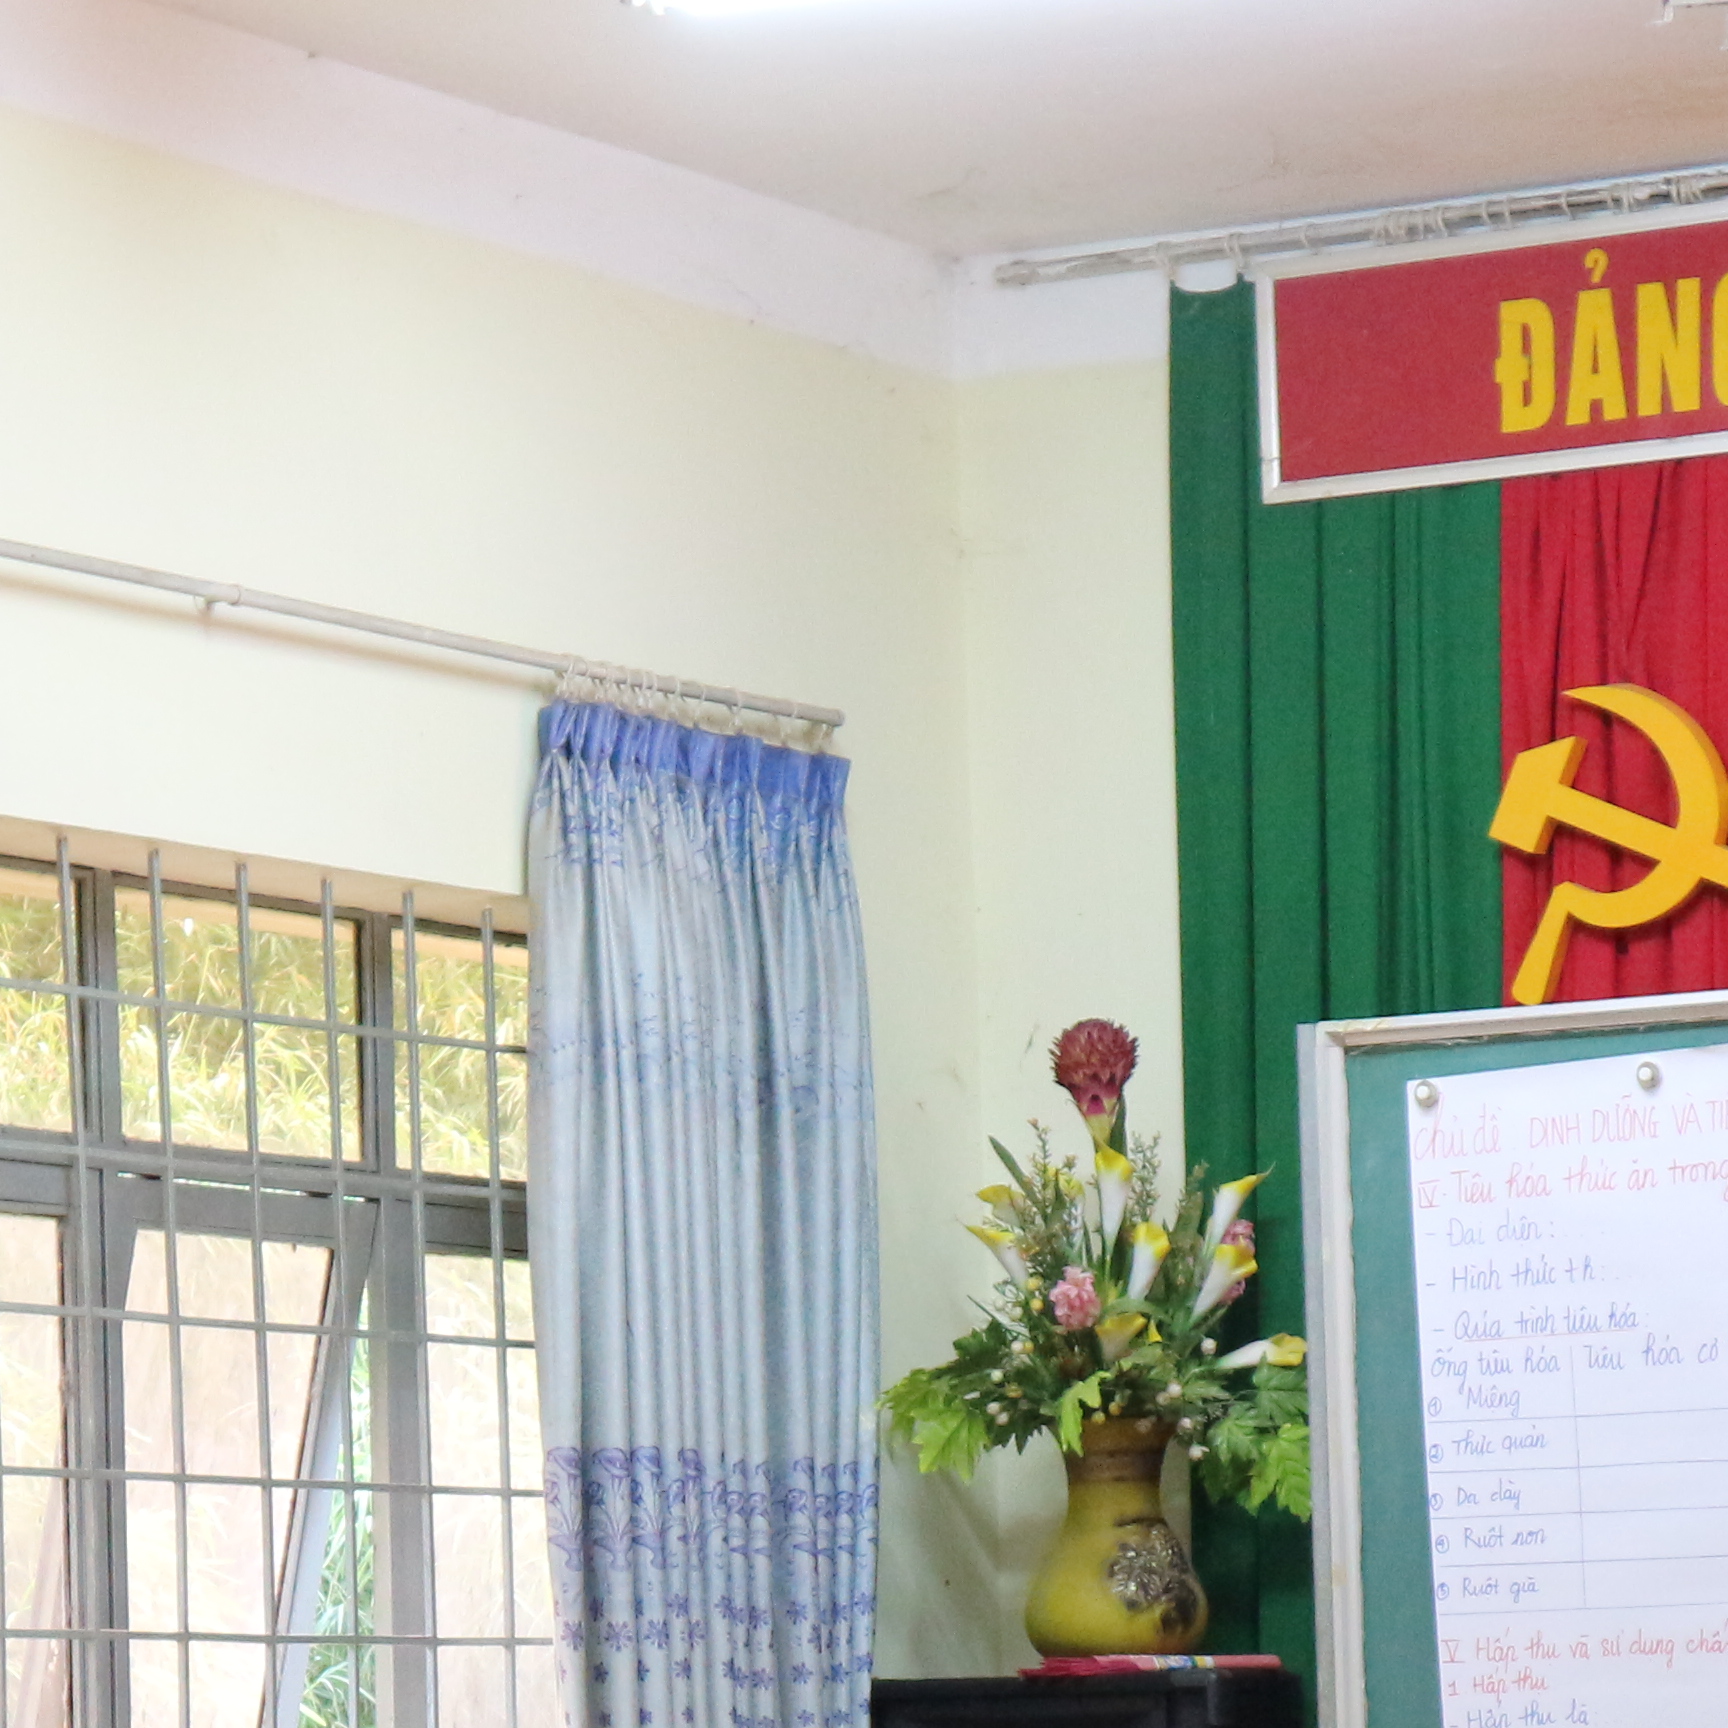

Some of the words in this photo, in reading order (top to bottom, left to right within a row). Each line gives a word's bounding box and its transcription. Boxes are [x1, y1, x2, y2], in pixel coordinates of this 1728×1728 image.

[1529, 1113, 1581, 1149] DINH
[1671, 1092, 1704, 1135] VÀ
[1450, 1170, 1497, 1205] Tiêu
[1627, 1159, 1659, 1191] ăn
[1452, 1258, 1502, 1292] Hình
[1514, 1305, 1557, 1334] trình
[1563, 1306, 1602, 1334] tiêu
[1478, 1349, 1514, 1376] tiêu
[1502, 1425, 1547, 1455] quản
[1490, 1478, 1522, 1510] dày
[1511, 1527, 1547, 1547] non
[1476, 1627, 1519, 1673] Hấp
[1473, 1667, 1509, 1702] Hấp
